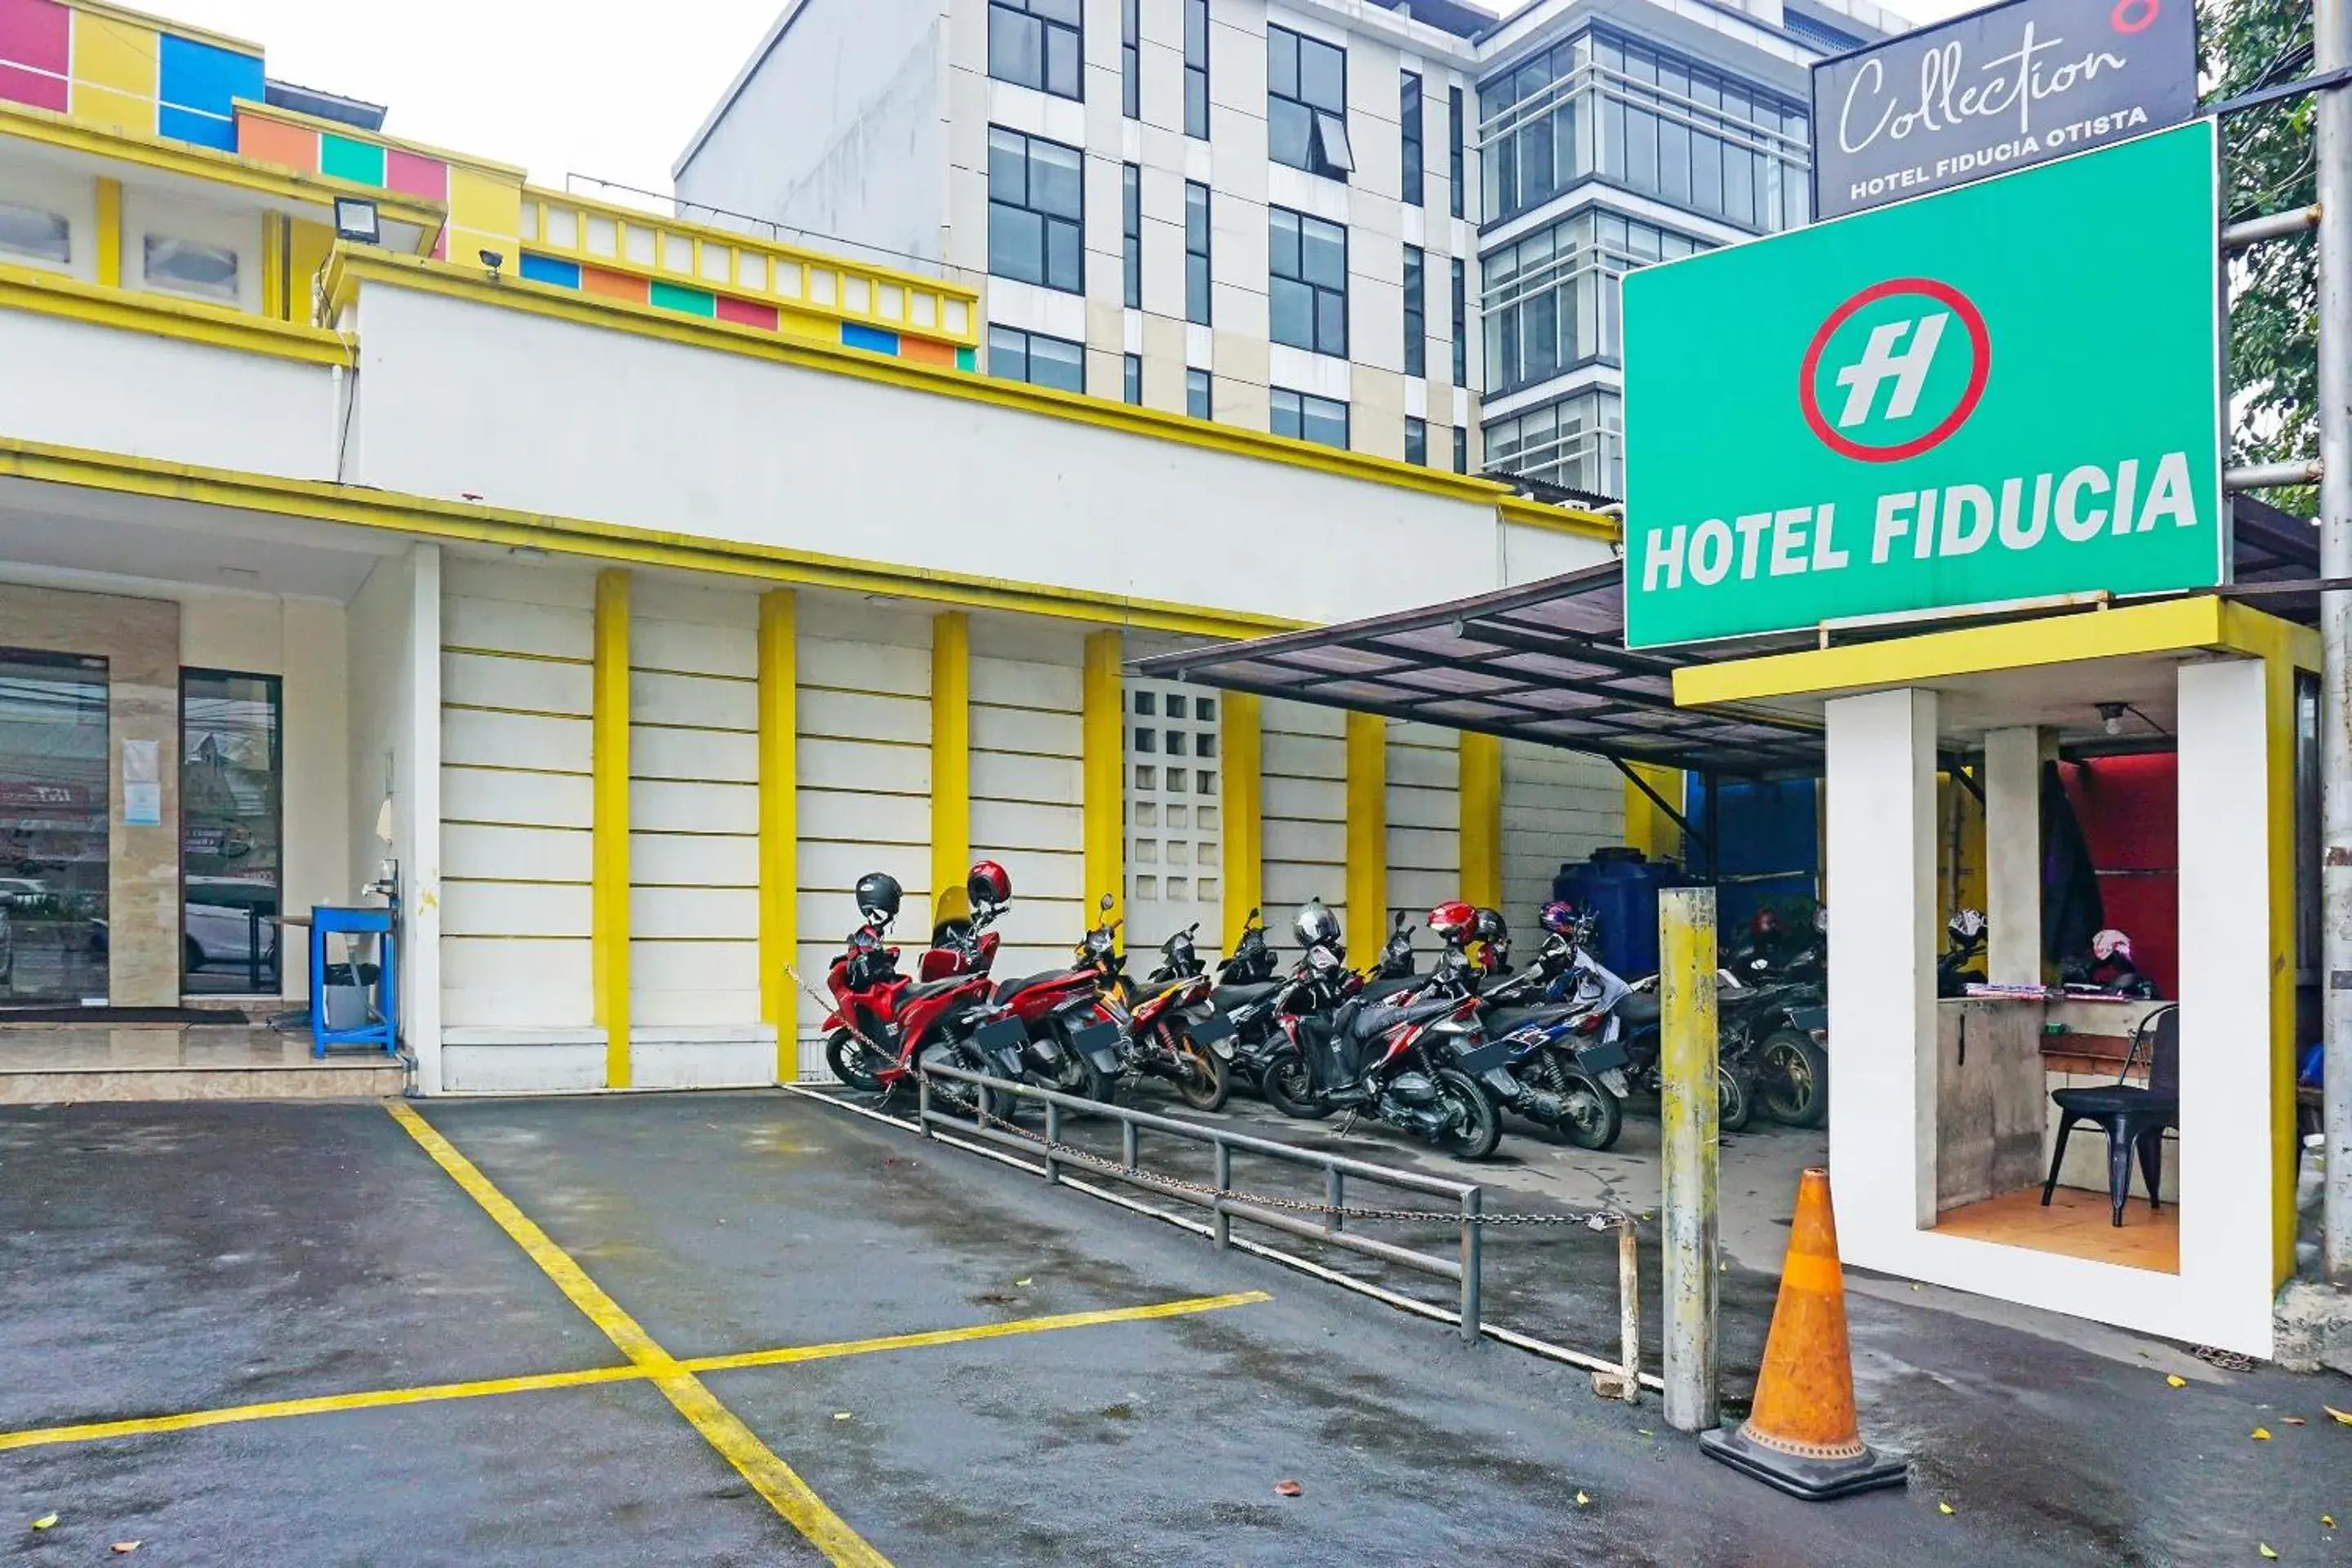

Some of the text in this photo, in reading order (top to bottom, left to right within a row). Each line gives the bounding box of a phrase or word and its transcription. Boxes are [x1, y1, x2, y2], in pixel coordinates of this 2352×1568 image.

[1839, 21, 2125, 154] Collection
[1851, 107, 2148, 200] HOTEL FIDUCIA OTISTA
[1643, 452, 2197, 591] HOTEL FIDUCIA
